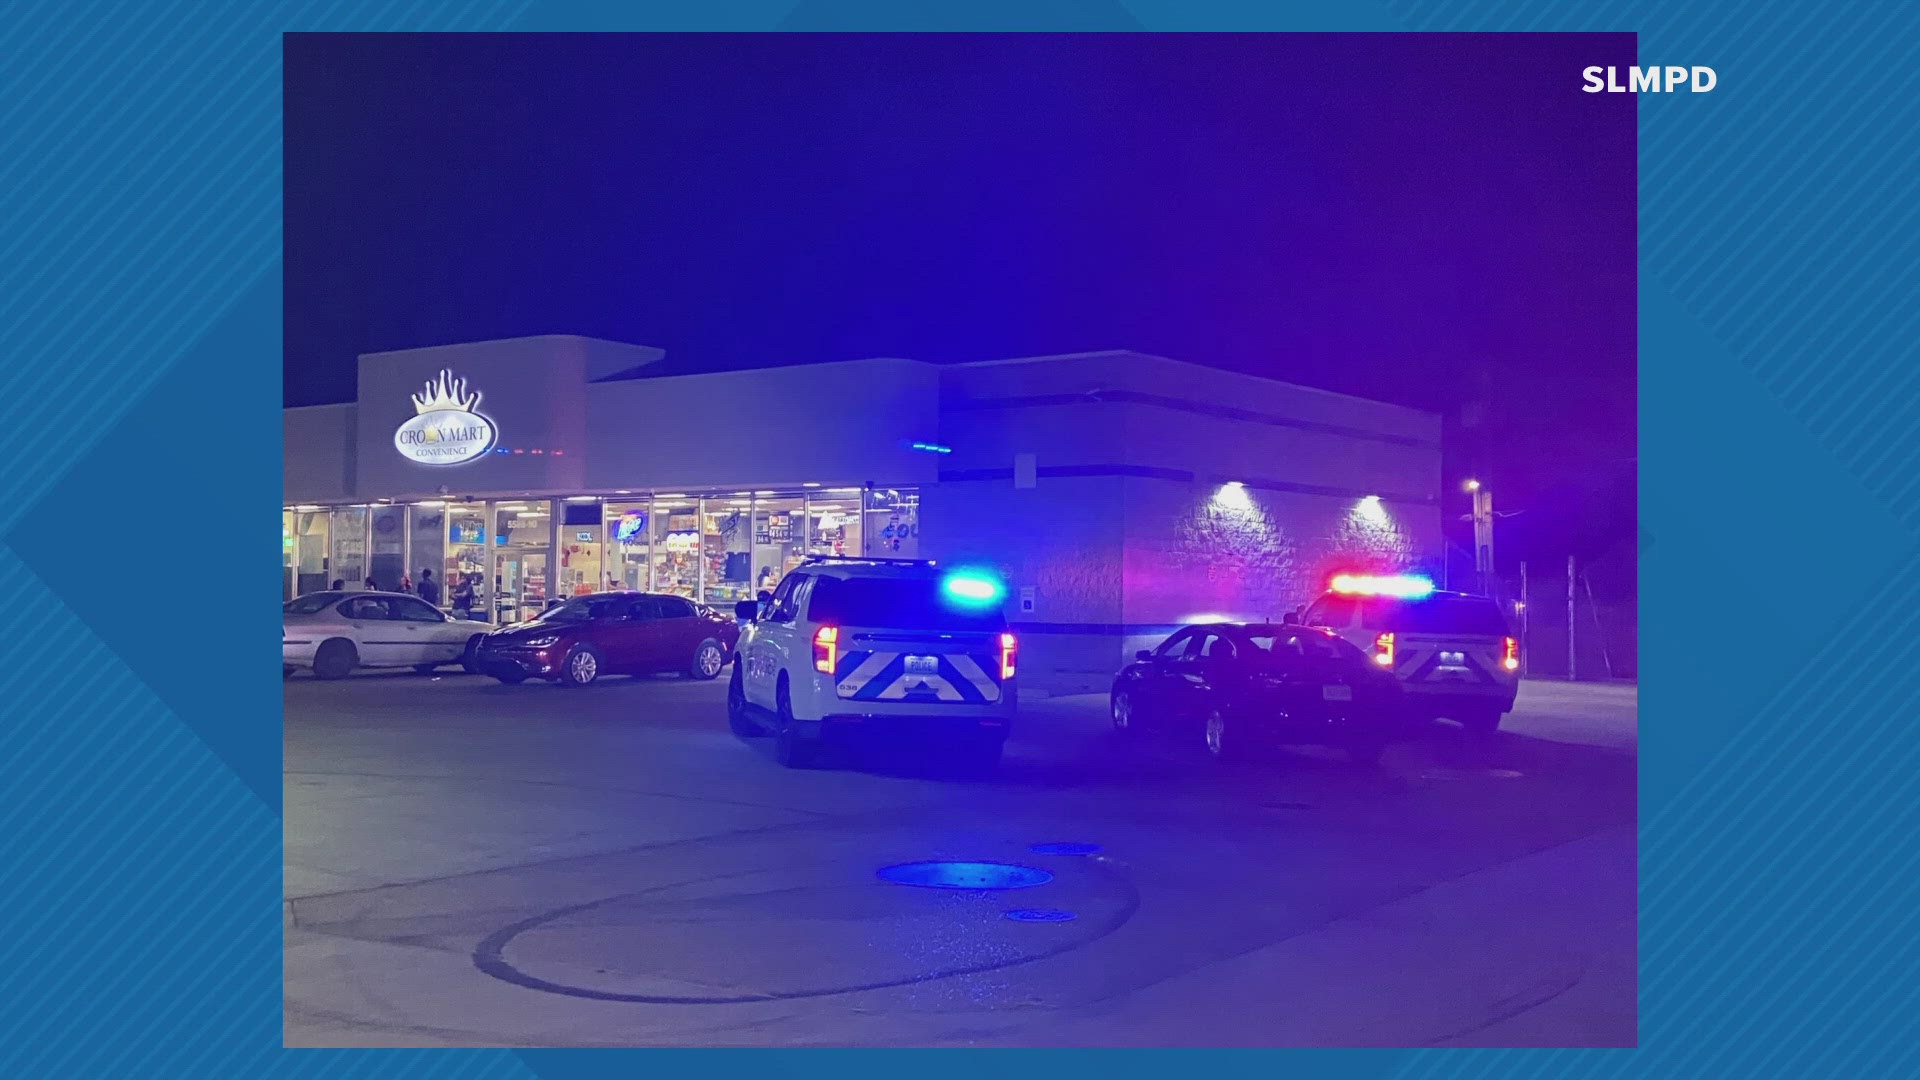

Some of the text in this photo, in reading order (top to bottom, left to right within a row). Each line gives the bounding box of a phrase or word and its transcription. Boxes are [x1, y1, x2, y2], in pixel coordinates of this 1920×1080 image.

[400, 426, 486, 446] CRON MART
[416, 446, 468, 457] CONVENIENCE
[911, 661, 932, 672] POLICE
